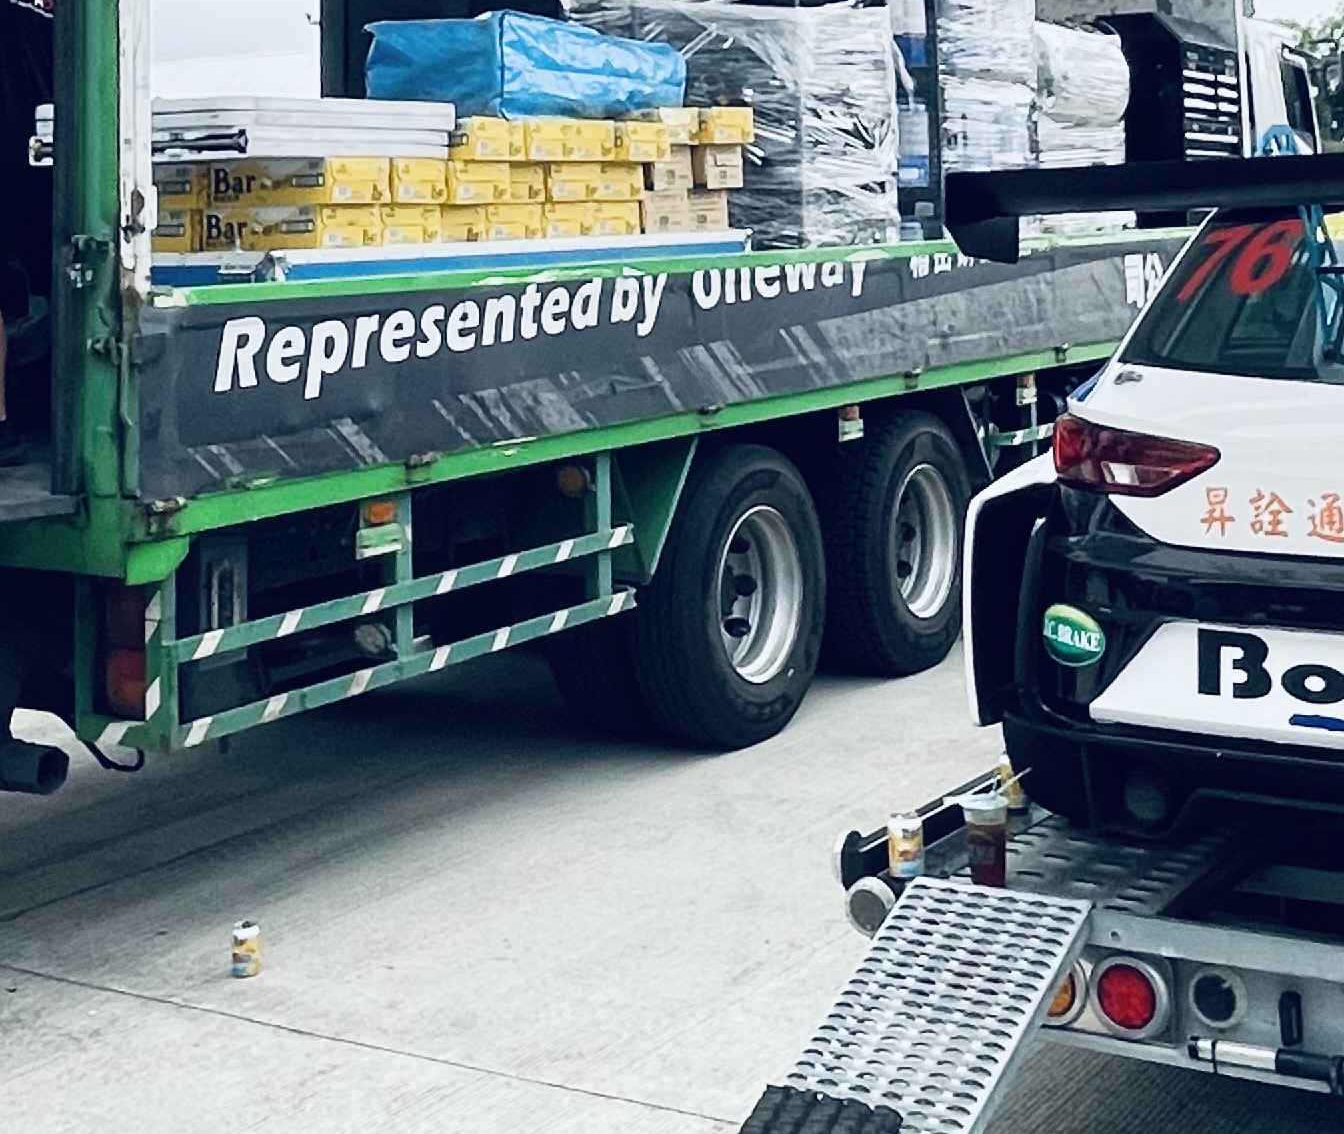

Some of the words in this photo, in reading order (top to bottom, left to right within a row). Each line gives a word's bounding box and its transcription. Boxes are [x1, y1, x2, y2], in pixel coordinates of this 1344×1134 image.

[213, 167, 256, 195] Bar
[206, 214, 248, 240] Bar
[1175, 218, 1306, 304] 76
[214, 277, 602, 400] Represented
[610, 271, 668, 338] by
[1057, 623, 1102, 653] BRAKE
